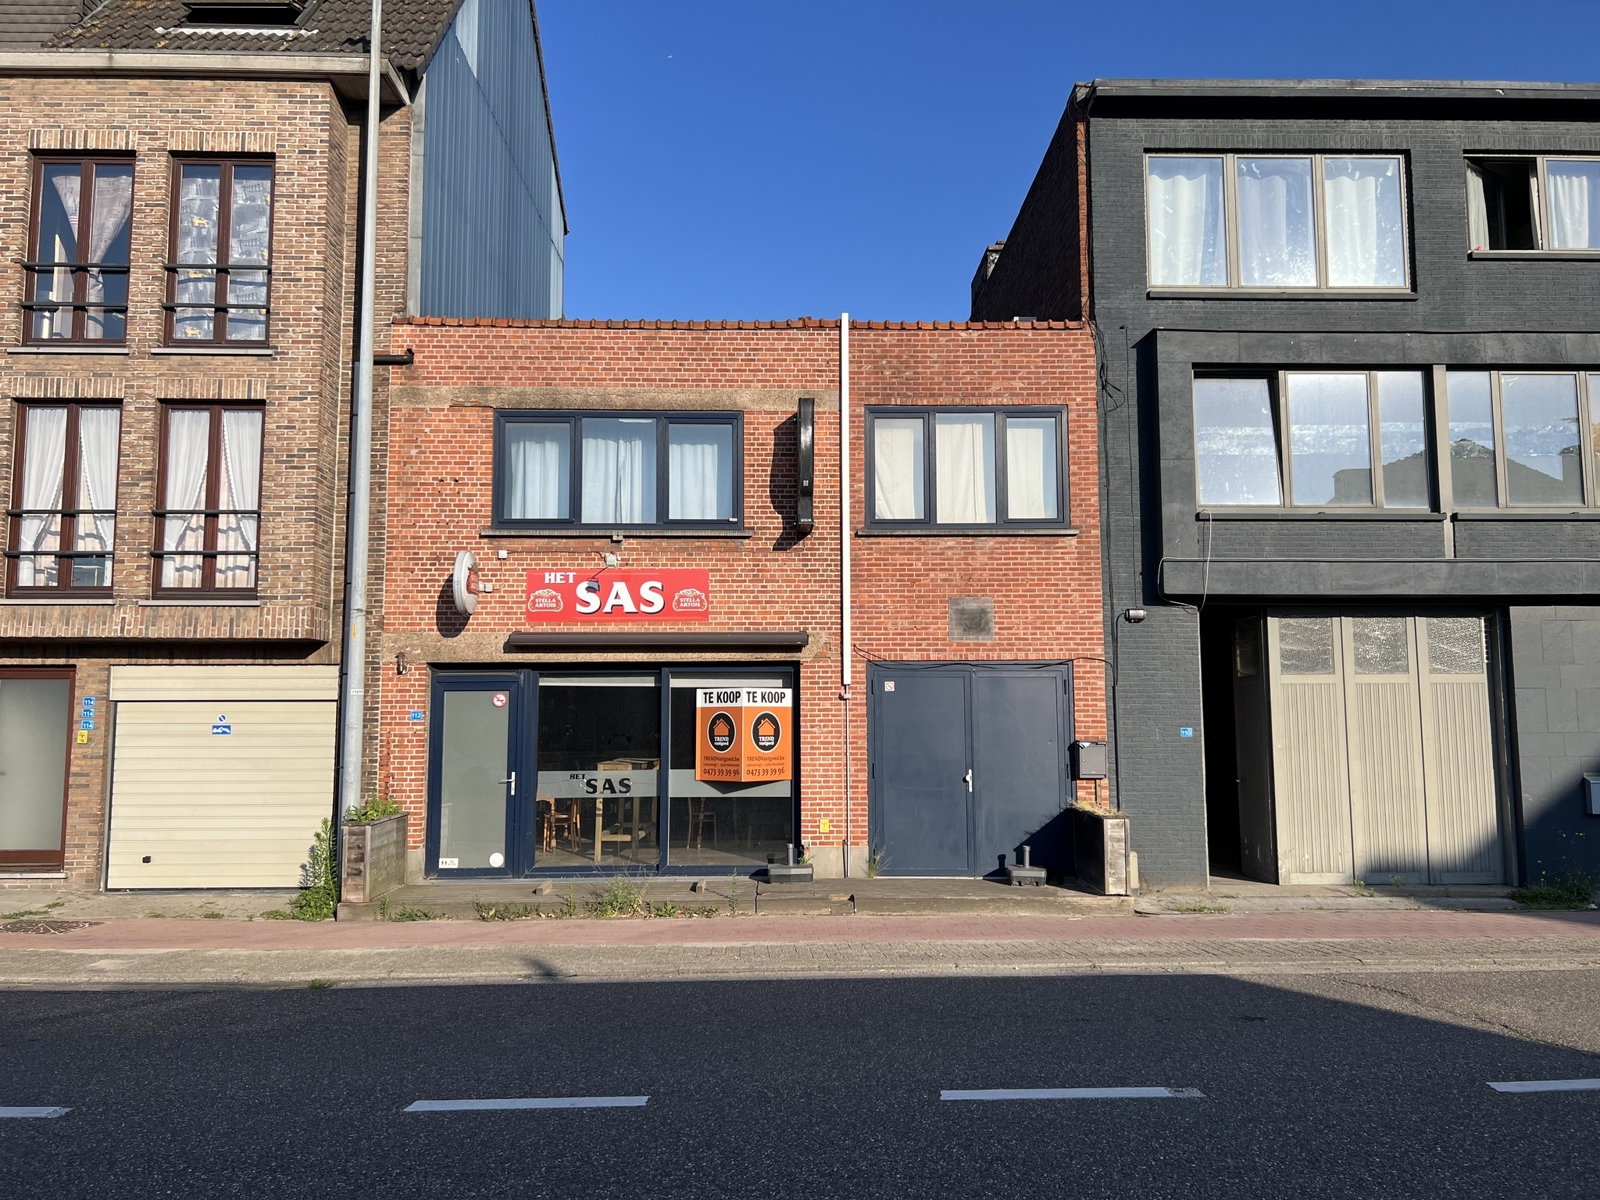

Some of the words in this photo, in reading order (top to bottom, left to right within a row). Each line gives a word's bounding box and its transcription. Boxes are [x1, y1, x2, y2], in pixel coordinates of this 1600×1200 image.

[544, 572, 576, 584] HET
[575, 580, 665, 614] SAS
[703, 692, 714, 704] TE
[716, 691, 741, 704] KOOP
[746, 691, 757, 703] TE
[761, 691, 786, 703] KOOP
[733, 768, 740, 777] 96
[778, 767, 785, 775] 96
[586, 778, 631, 794] SAS
